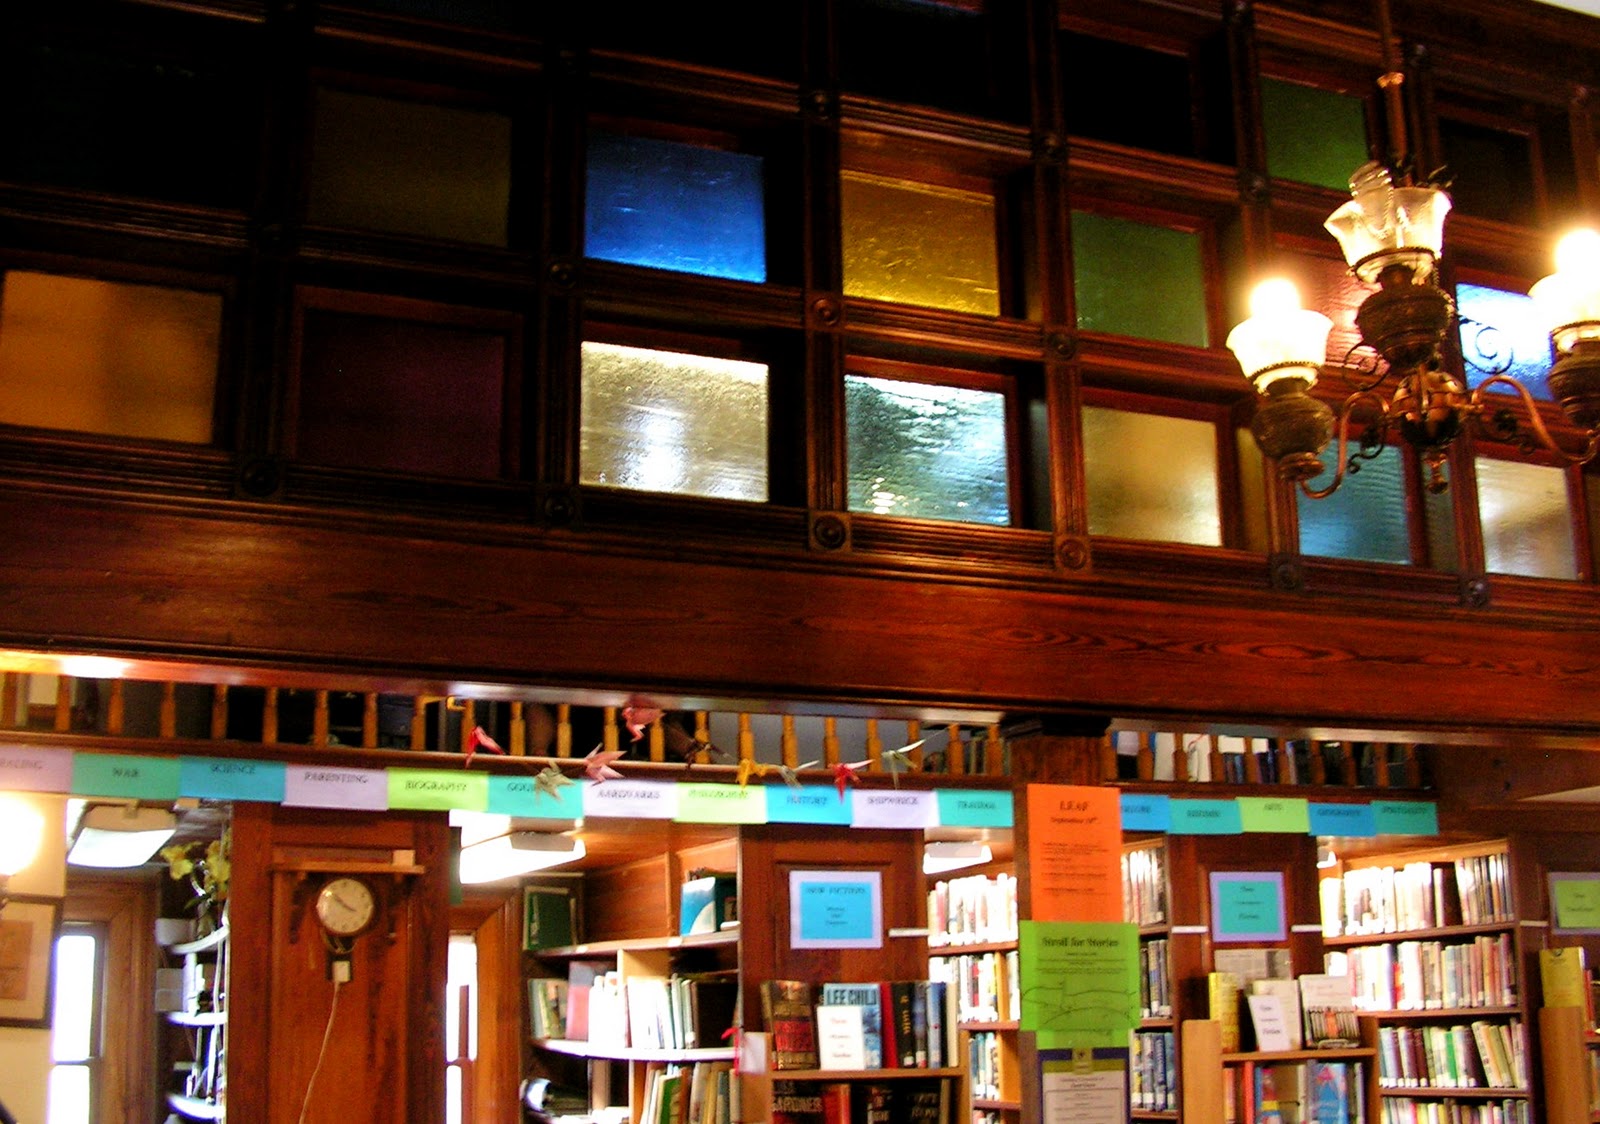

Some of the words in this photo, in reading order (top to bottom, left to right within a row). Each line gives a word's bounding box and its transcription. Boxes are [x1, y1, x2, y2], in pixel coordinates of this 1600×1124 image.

[304, 771, 368, 784] PARENTING
[405, 780, 467, 792] BIOGRAPHY
[826, 989, 846, 1006] LEE
[849, 989, 878, 1006] CHILD
